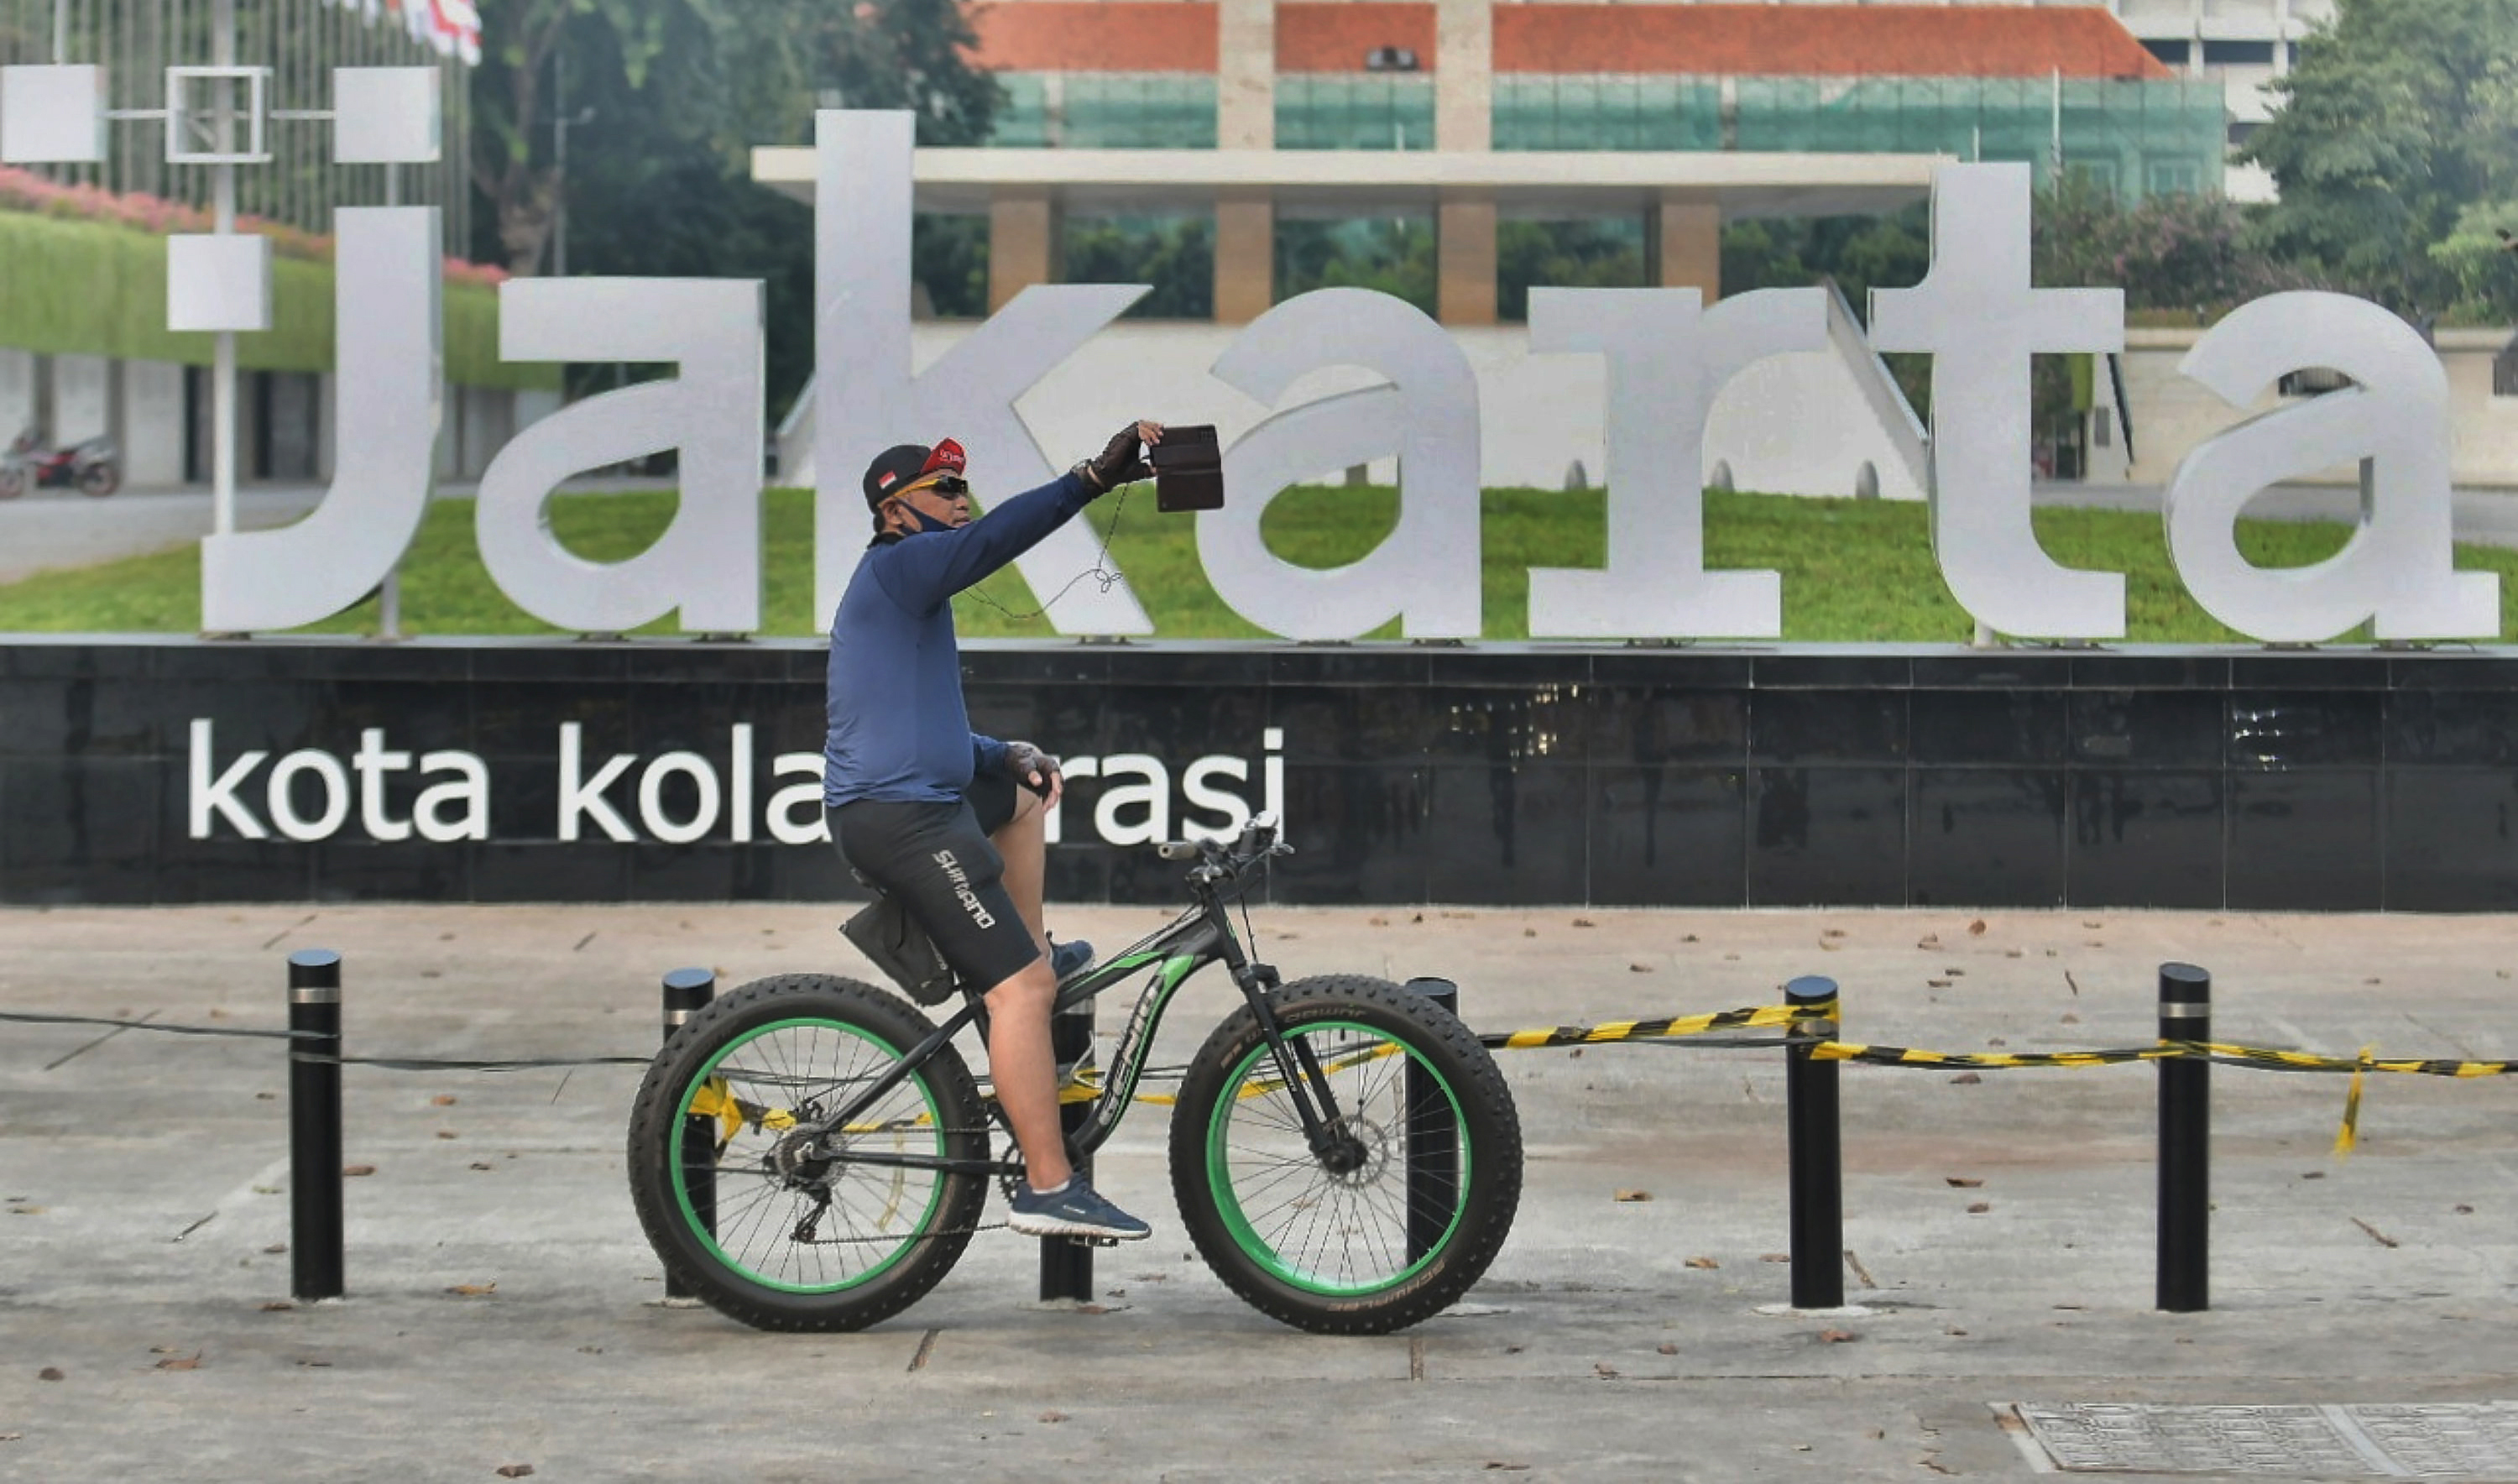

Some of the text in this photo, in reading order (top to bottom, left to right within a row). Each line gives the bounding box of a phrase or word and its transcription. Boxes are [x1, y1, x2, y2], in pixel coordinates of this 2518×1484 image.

[201, 66, 2500, 643] jakarta
[190, 718, 1284, 844] kota kolarasi
